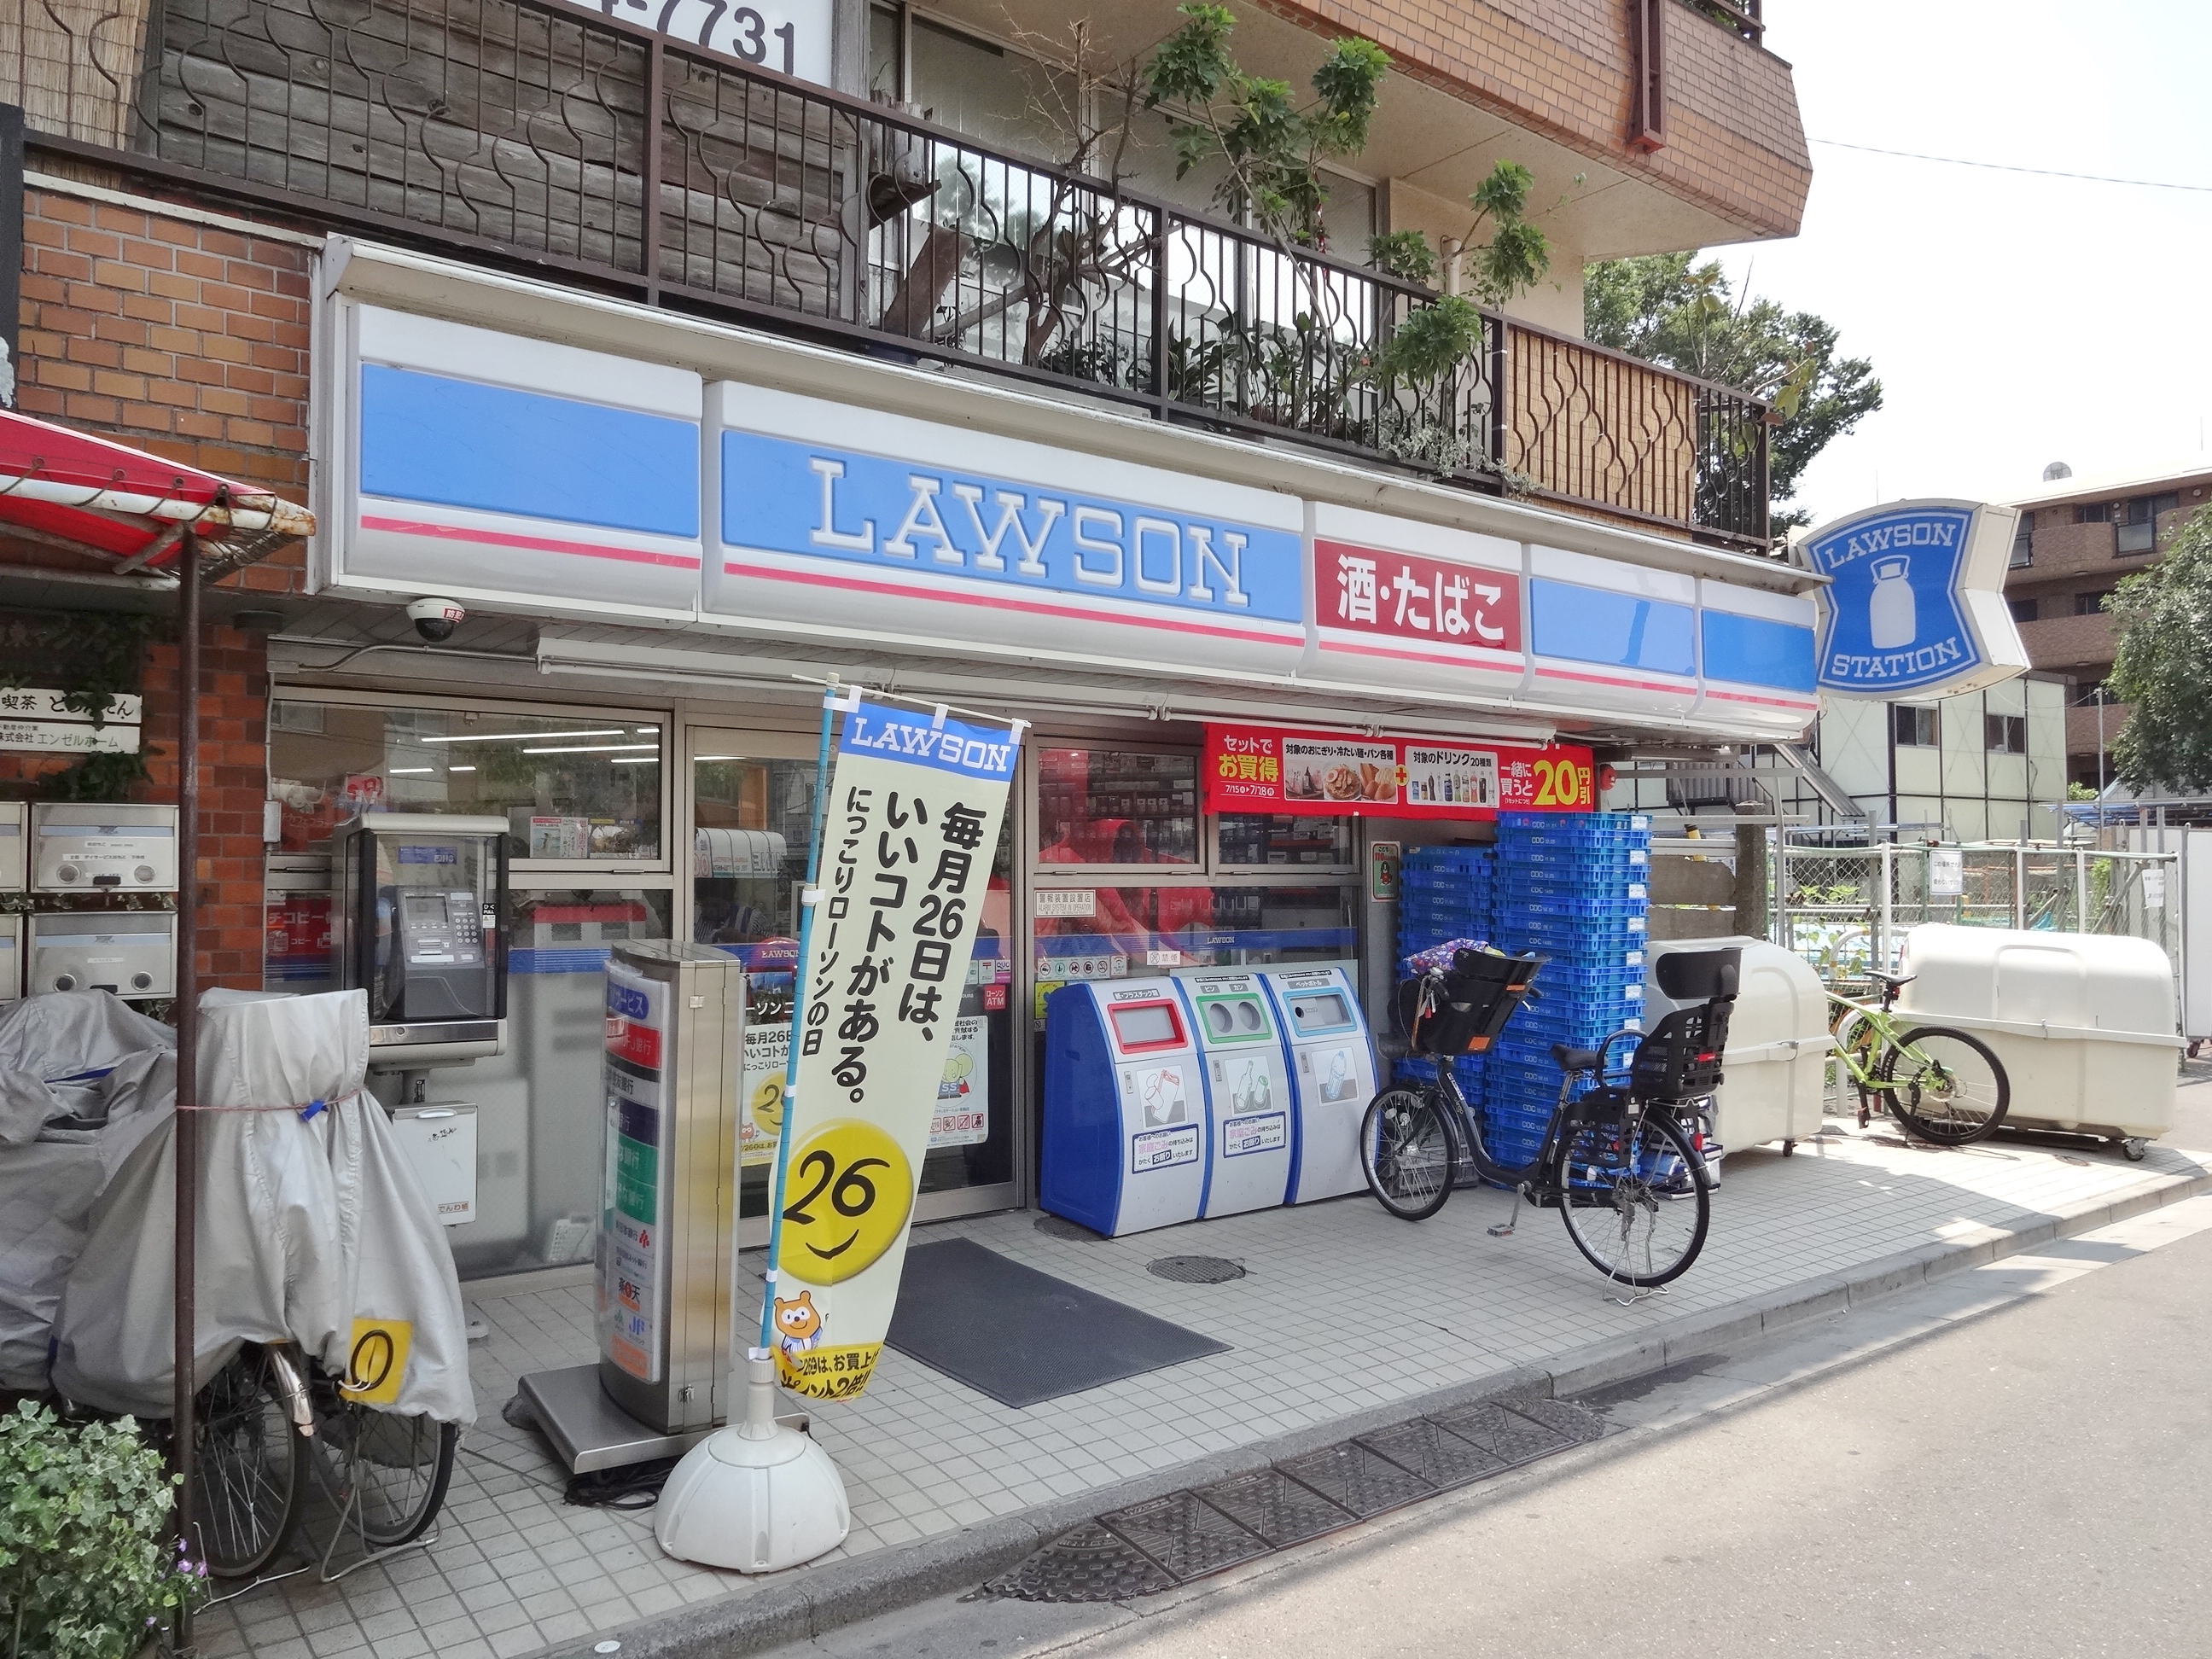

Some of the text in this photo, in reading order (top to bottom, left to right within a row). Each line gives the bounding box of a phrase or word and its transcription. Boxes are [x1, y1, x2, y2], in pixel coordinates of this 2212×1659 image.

[811, 458, 1248, 607] LAWSON
[1825, 522, 1956, 569] LAWSON
[1336, 553, 1505, 640] 酒・たばこ
[1831, 637, 1962, 678] STATION
[2, 693, 38, 711] 喫茶
[0, 724, 39, 732] 動産仲介業
[38, 733, 119, 748] エンゼルホーム
[851, 717, 1010, 772] LAWSON
[1224, 734, 1273, 754] セットで
[1219, 754, 1278, 783] お買得
[1500, 760, 1533, 777] 一緒に
[1500, 777, 1534, 796] 買うと
[1533, 760, 1579, 806] 20
[1577, 766, 1591, 805] 円引
[1038, 904, 1052, 912] ALARM
[1072, 903, 1092, 911] OPERATION
[1039, 893, 1091, 905] 警報装置設置店
[802, 786, 872, 1056] にっこりローソンの日
[899, 802, 987, 1042] 毎月26日は、
[831, 790, 928, 1103] いいコトがある。
[1161, 952, 1178, 963] 禁煙
[986, 998, 1004, 1006] ATM
[1524, 1037, 1537, 1045] CDC
[1524, 1072, 1538, 1080] CDC
[1522, 1103, 1536, 1112] CDC
[1229, 1124, 1281, 1140] 家庭ごみの持ち込みは
[1522, 1121, 1535, 1130] CDC
[1138, 1137, 1193, 1154] 家庭ごみの持ち込みは
[1522, 1138, 1535, 1147] CDC
[783, 1150, 890, 1224] 26
[438, 1202, 469, 1213] でんわ帳
